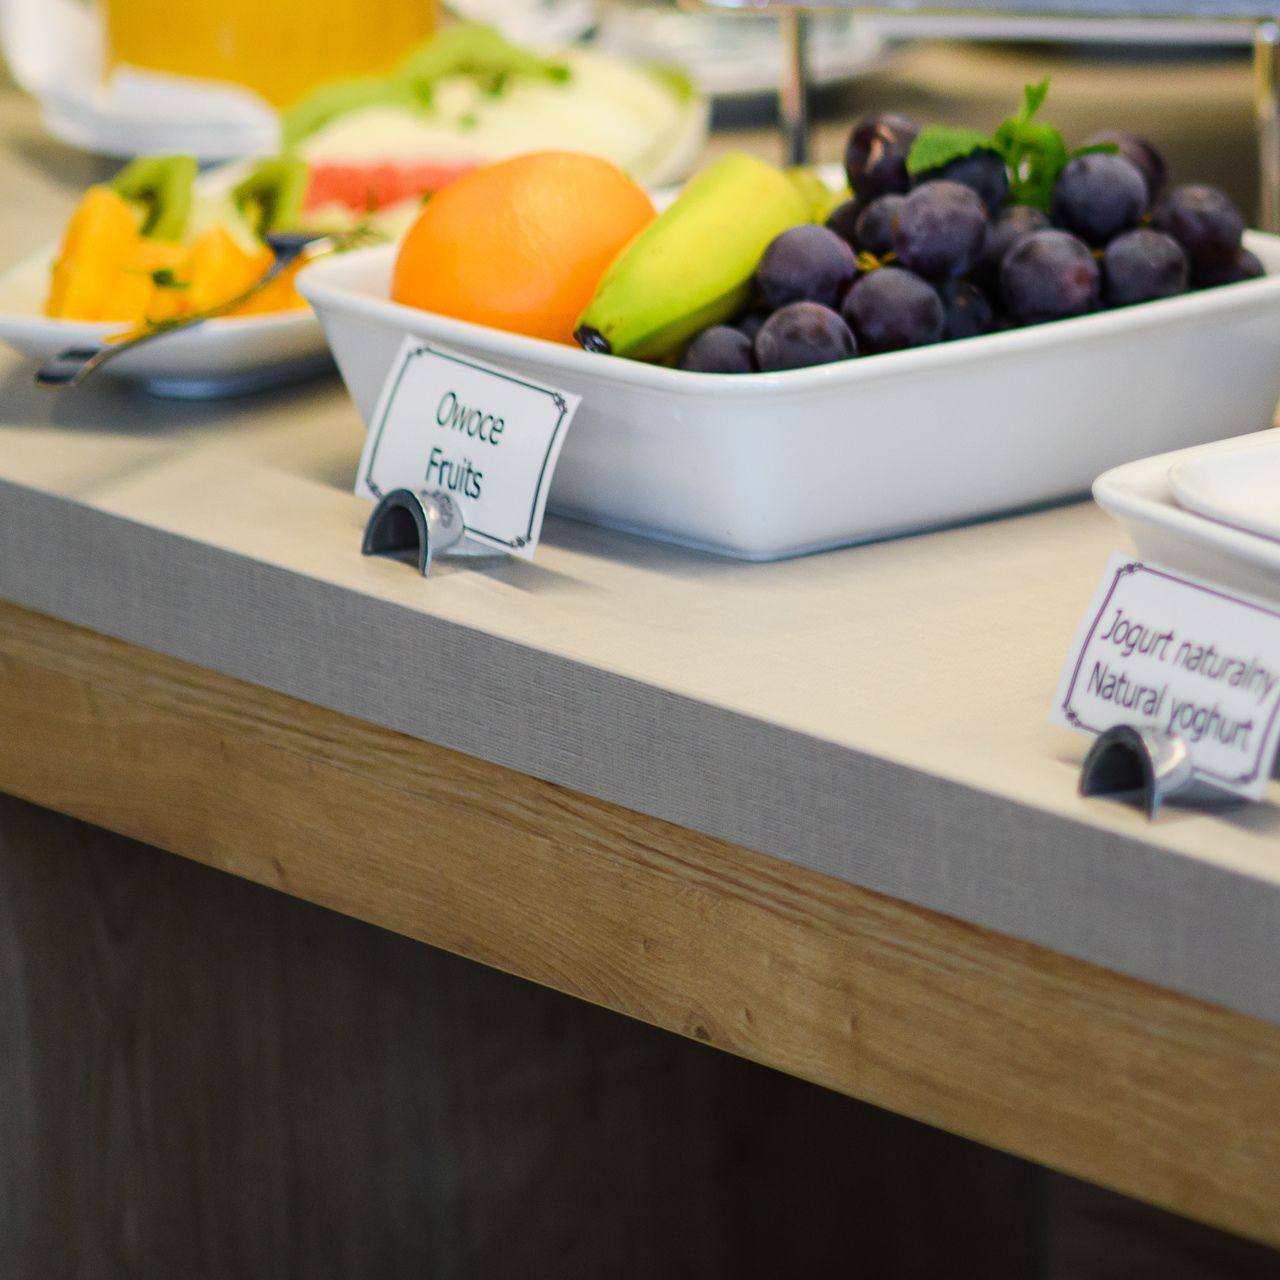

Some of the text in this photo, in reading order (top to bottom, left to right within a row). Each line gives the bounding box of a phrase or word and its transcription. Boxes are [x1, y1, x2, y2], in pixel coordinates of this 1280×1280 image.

[436, 391, 505, 445] Owoce
[425, 447, 484, 500] Fruits
[1101, 608, 1175, 662] Jogurt
[1086, 660, 1254, 753] Natural yoghurt
